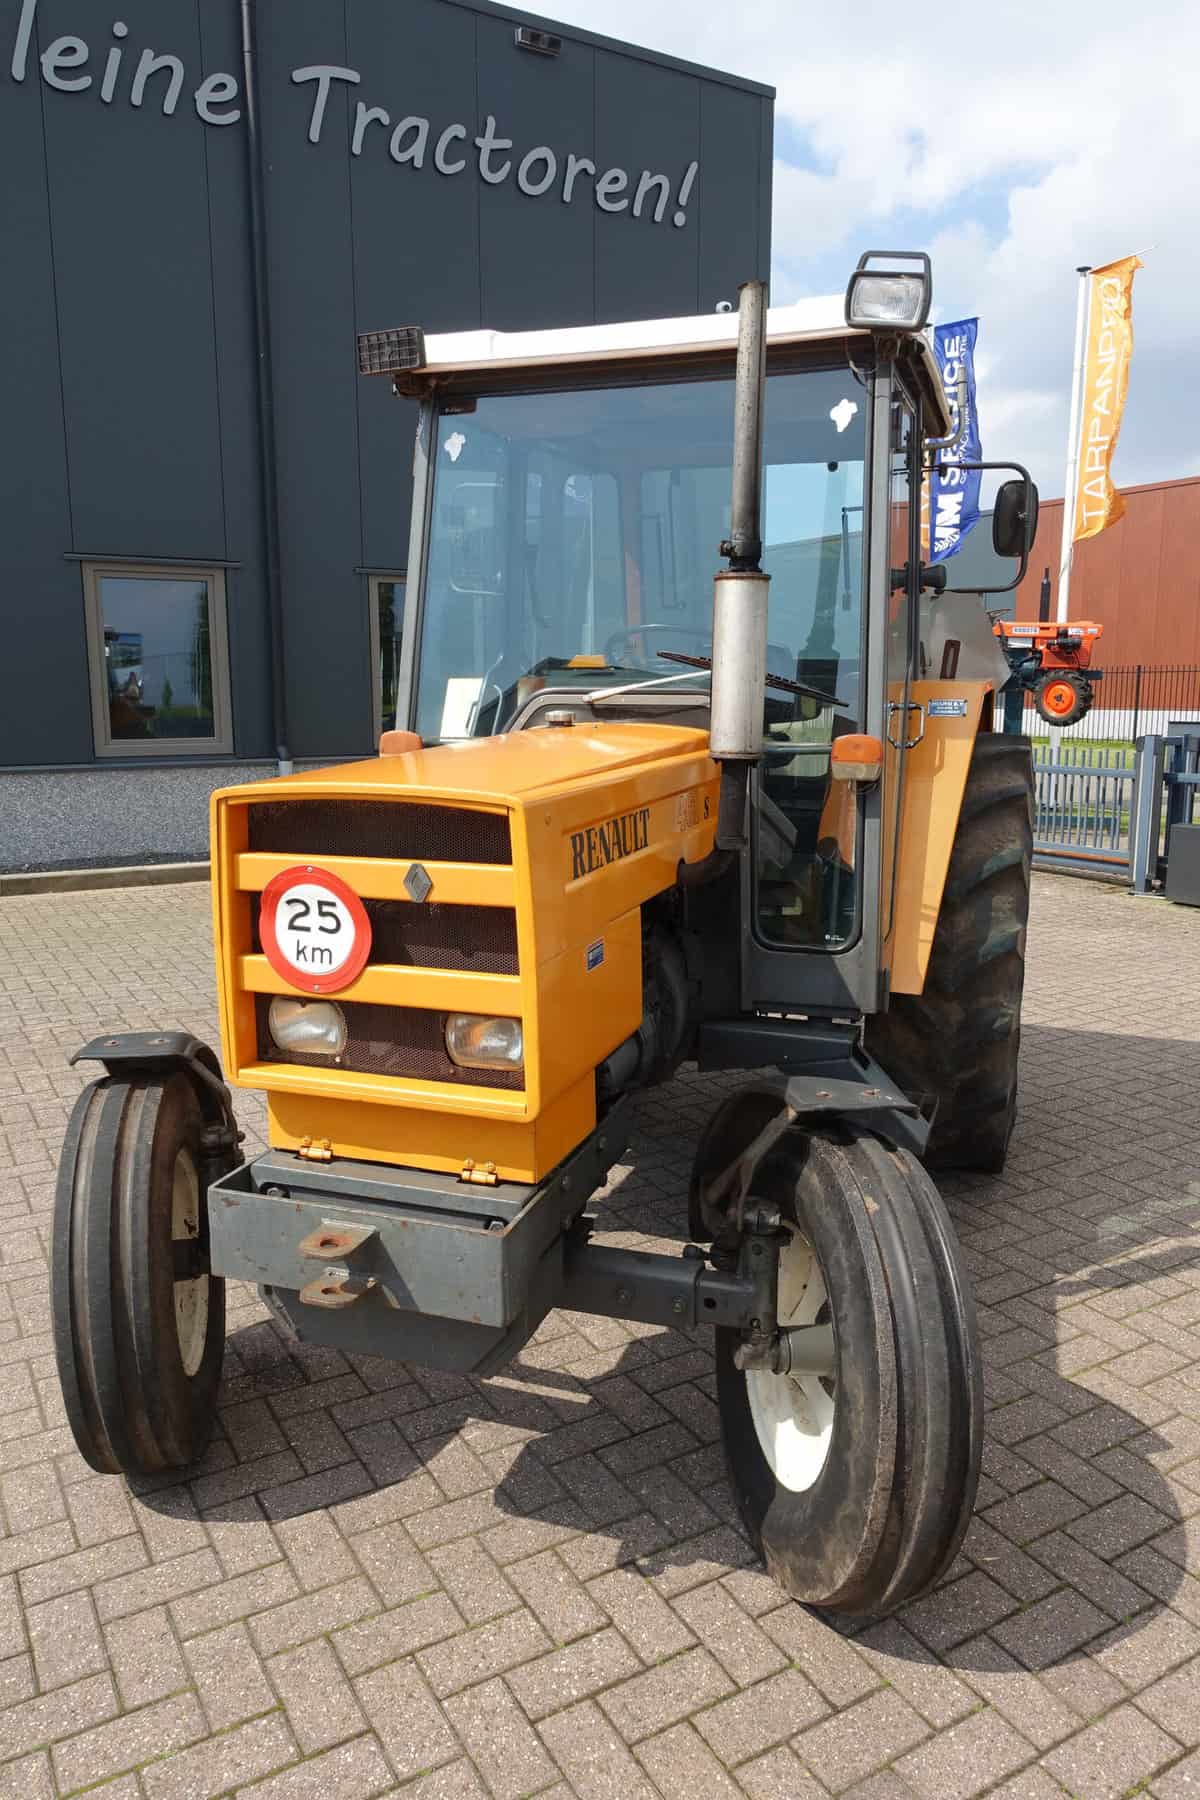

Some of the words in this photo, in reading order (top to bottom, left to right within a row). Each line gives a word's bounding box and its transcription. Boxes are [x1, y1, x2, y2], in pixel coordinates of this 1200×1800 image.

[11, 0, 241, 125] leine
[291, 65, 698, 227] Tractoren!
[570, 808, 650, 880] RENAULT
[286, 898, 341, 934] 25
[296, 939, 333, 965] km
